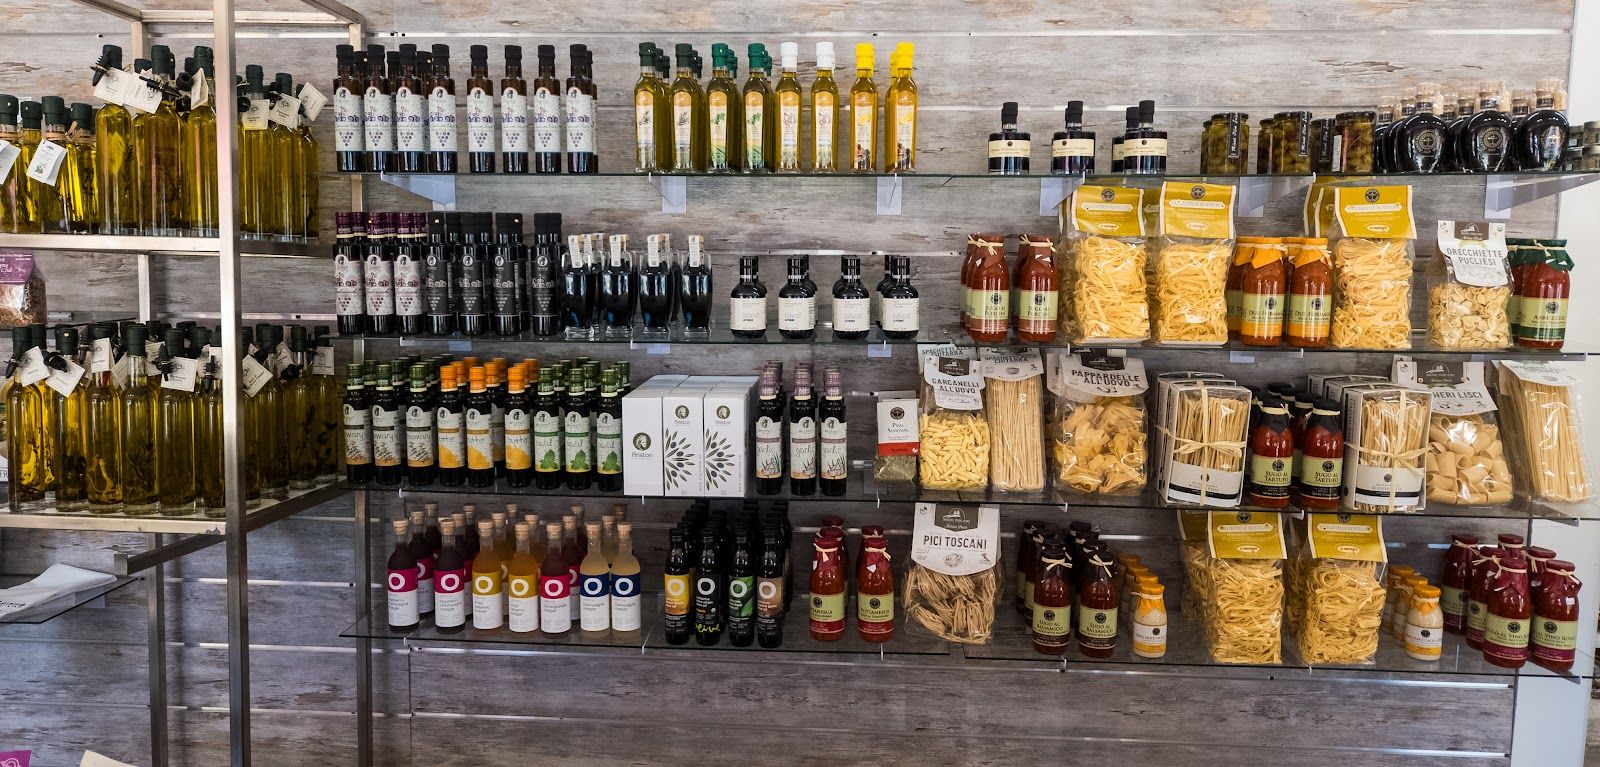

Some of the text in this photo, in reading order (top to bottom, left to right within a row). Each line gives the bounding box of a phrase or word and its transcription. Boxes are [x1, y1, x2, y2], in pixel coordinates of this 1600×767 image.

[1447, 248, 1504, 258] ORECCHIETTE
[1458, 256, 1497, 267] PUGLIESI
[1072, 369, 1141, 382] PAPPARDELLE
[1433, 391, 1484, 400] HERI LISCI
[1265, 470, 1283, 478] SUGO
[1315, 471, 1332, 479] SUGO
[923, 535, 988, 550] PICI TOSCANI
[1508, 633, 1524, 641] VINO
[1544, 633, 1561, 641] VINO
